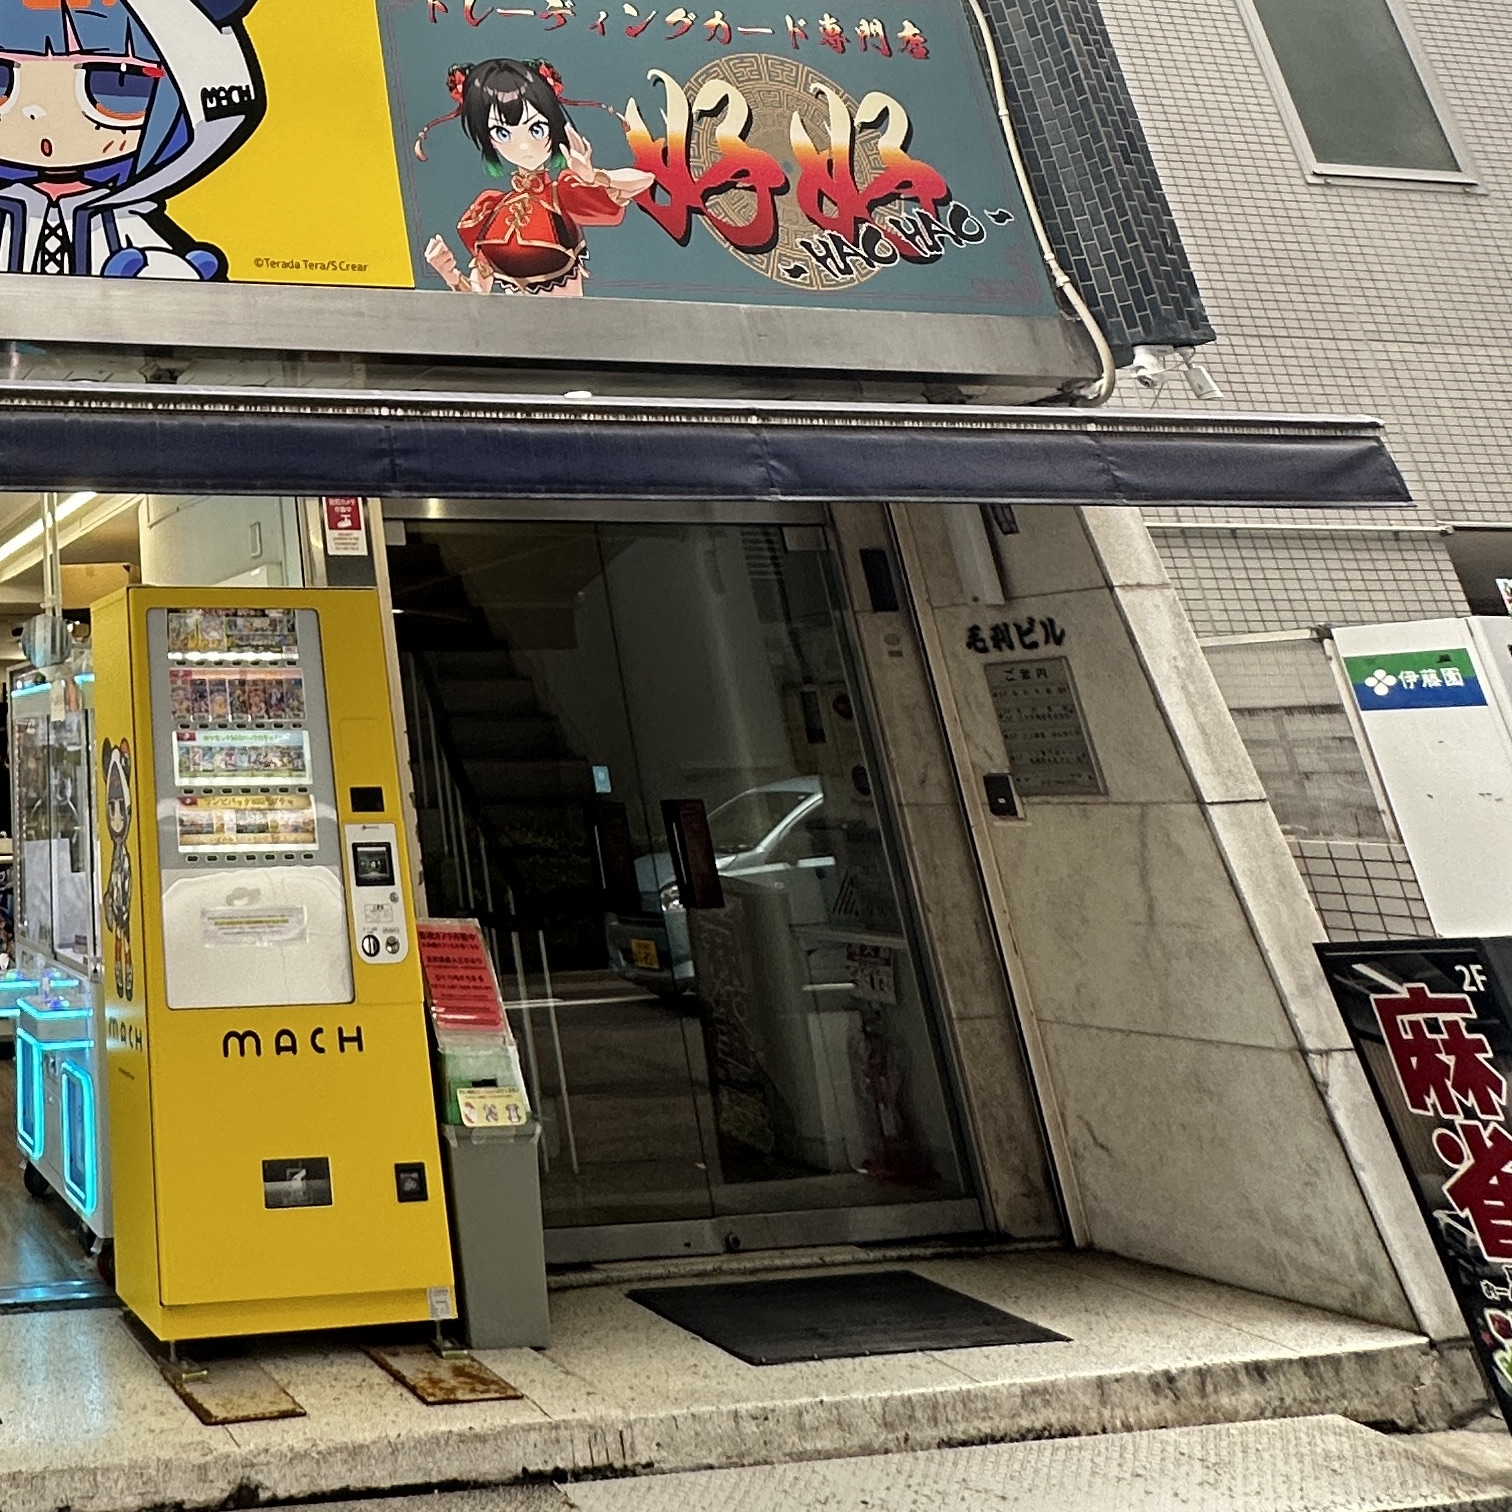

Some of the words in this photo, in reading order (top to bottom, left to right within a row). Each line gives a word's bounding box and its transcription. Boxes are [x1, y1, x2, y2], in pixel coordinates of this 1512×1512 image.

[624, 67, 952, 258] 好好
[800, 221, 900, 279] HAO
[890, 201, 987, 258] HAO
[1398, 666, 1465, 690] 伊藤園
[1455, 964, 1488, 993] 2F
[222, 1025, 365, 1058] MACH
